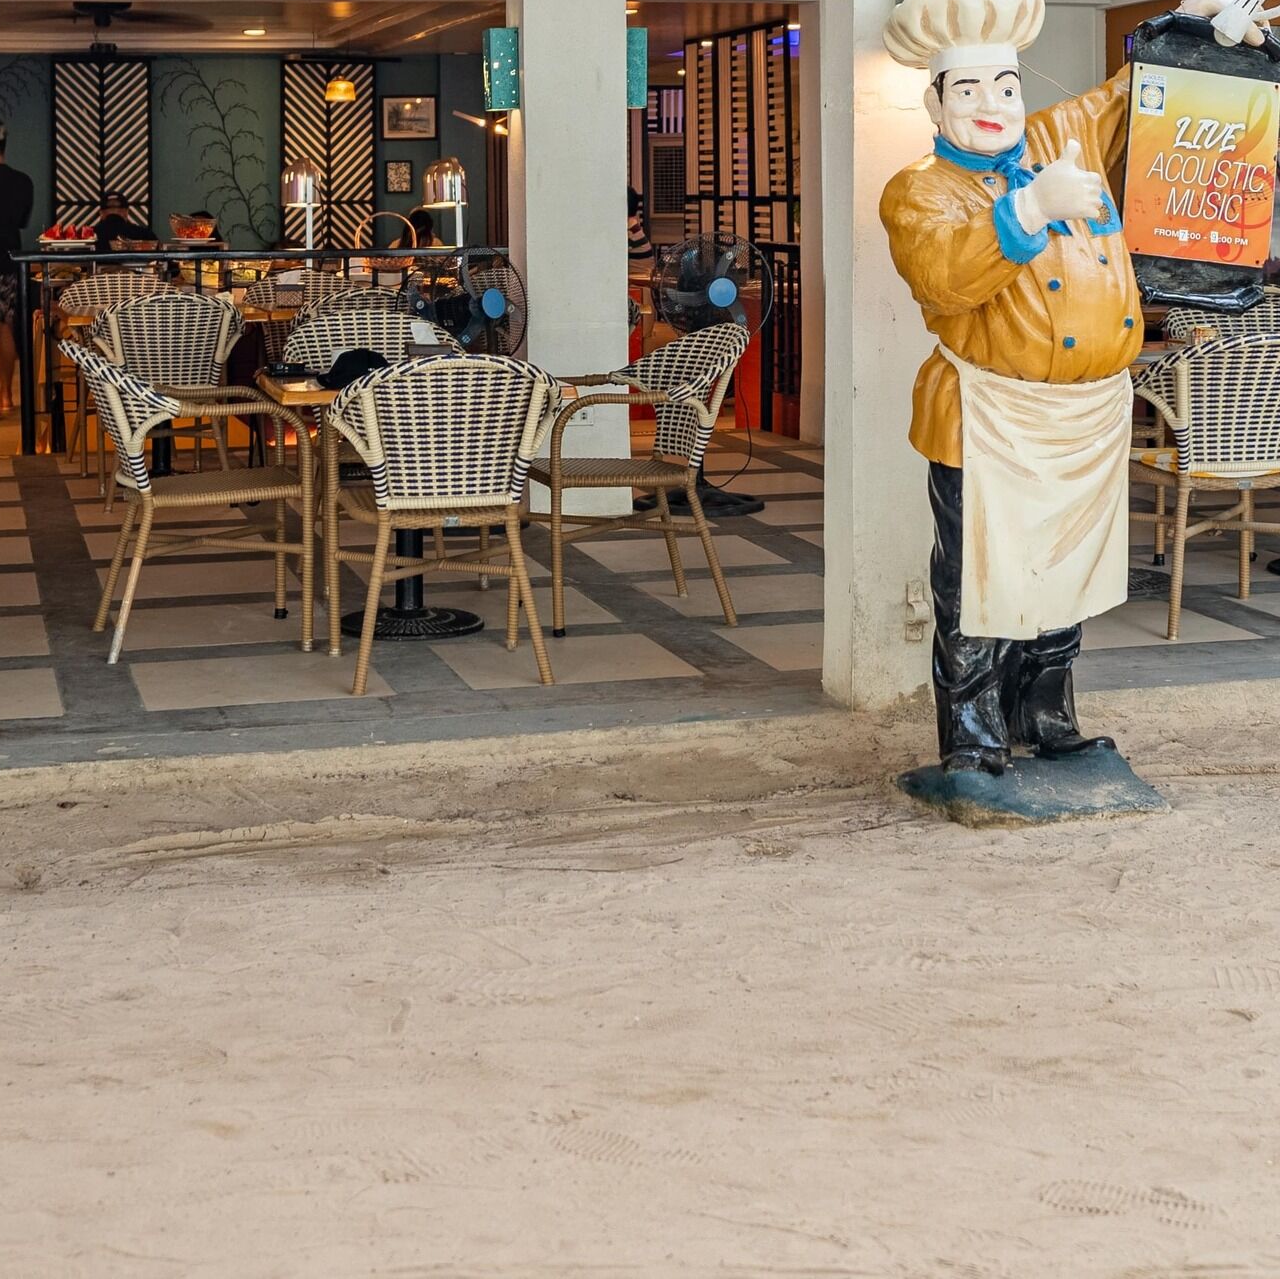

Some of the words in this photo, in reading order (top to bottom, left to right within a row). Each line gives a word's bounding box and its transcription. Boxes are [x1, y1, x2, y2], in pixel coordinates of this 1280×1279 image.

[1173, 116, 1246, 153] LIVE
[1146, 151, 1267, 193] ACOUSTIC
[1165, 186, 1243, 223] MUSIC
[1153, 227, 1179, 238] FROM
[1234, 237, 1249, 246] PM
